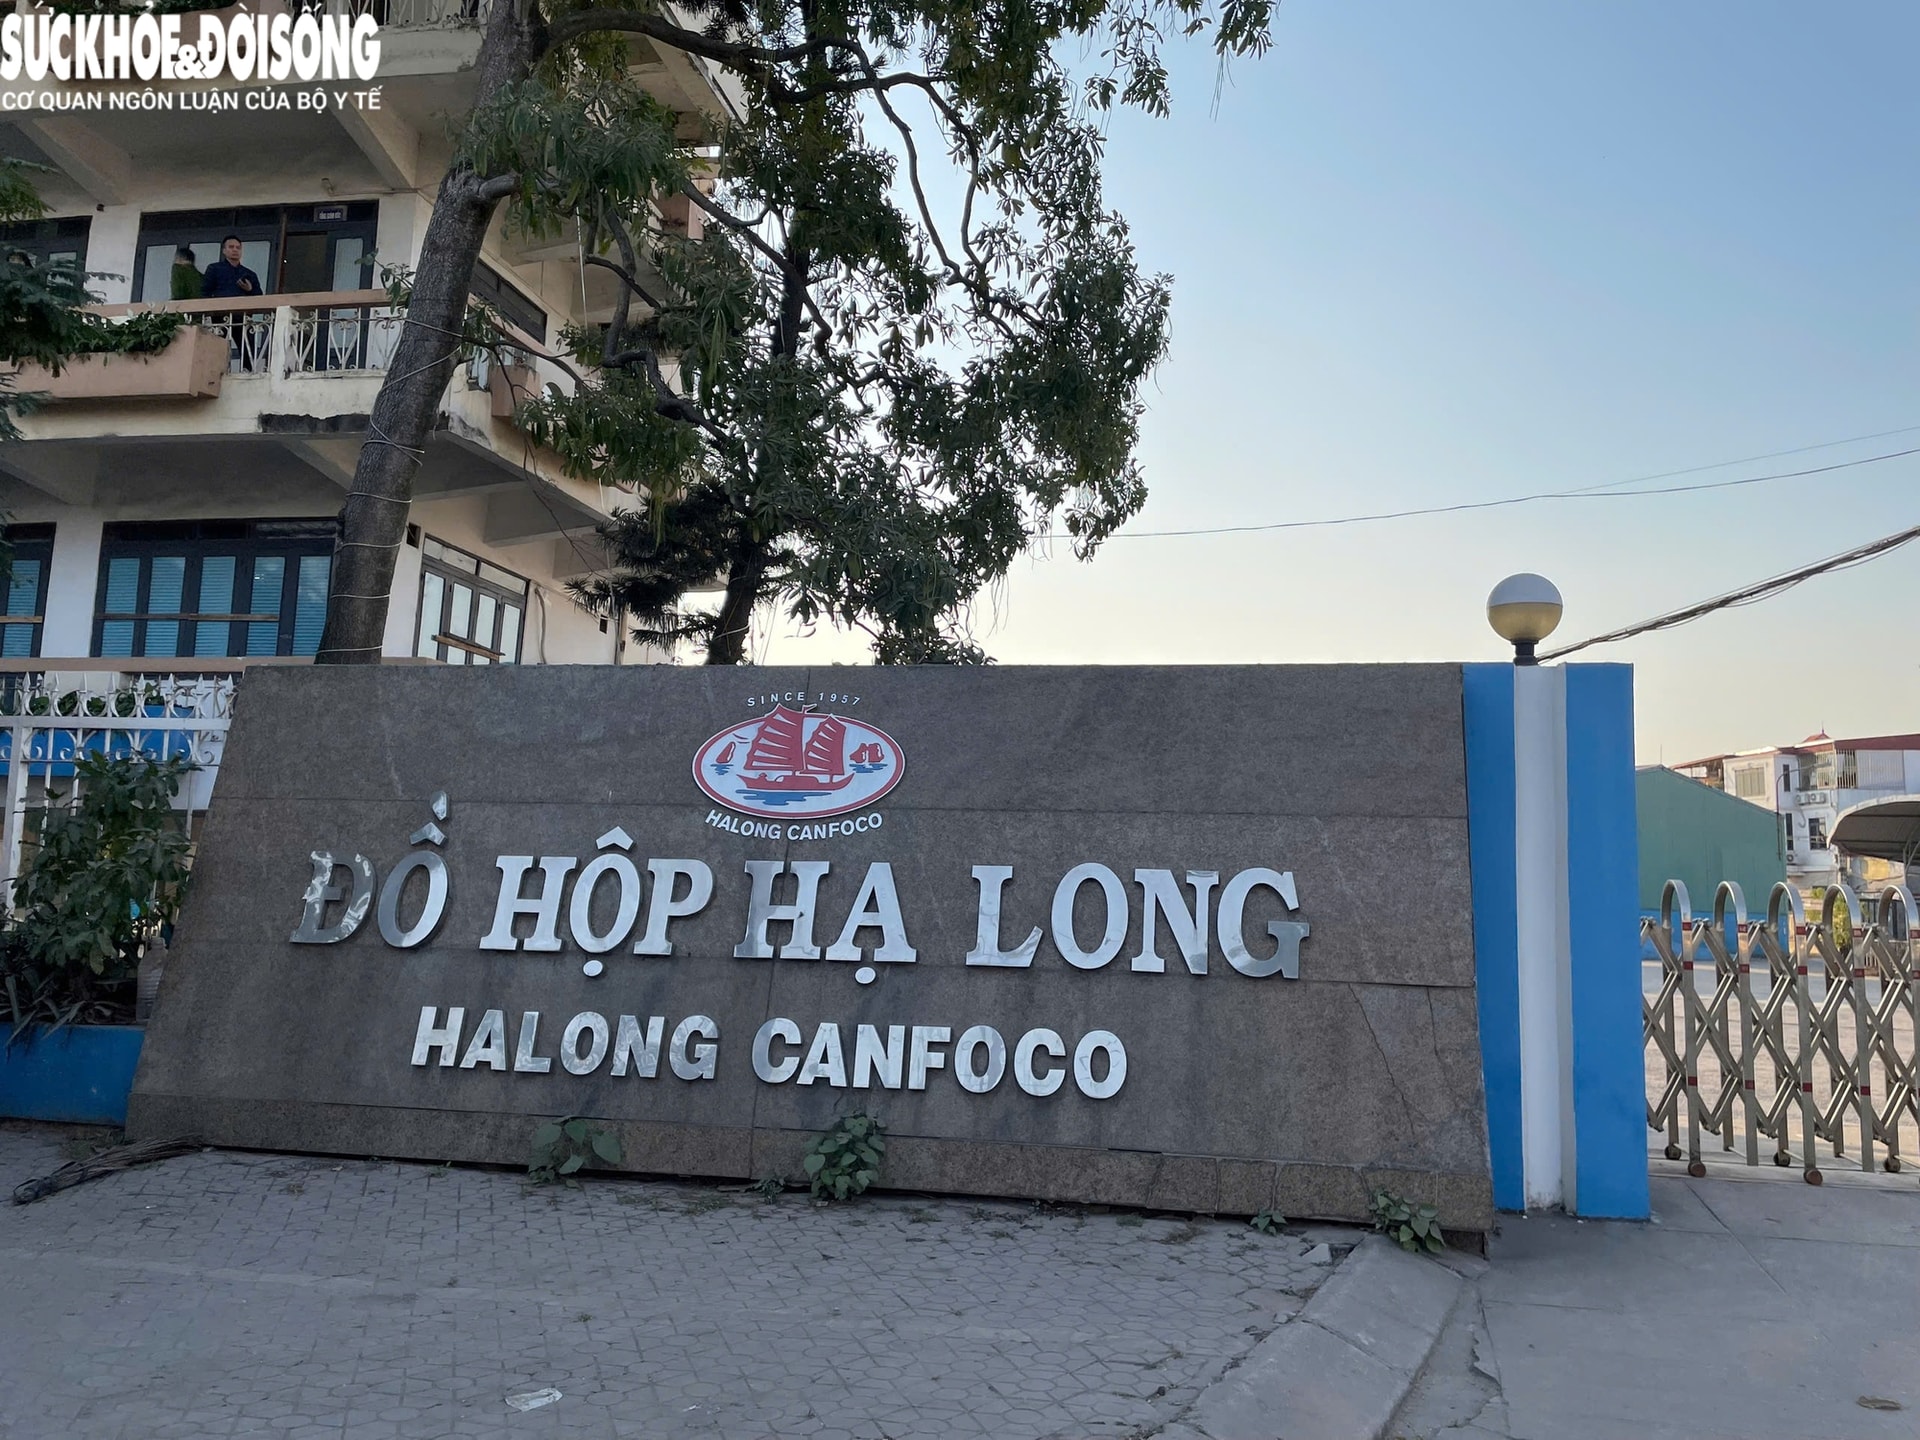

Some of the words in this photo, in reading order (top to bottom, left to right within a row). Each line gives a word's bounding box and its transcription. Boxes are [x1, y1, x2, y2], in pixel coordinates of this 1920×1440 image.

[747, 691, 805, 707] SINCE
[818, 691, 861, 706] 1957
[705, 809, 782, 840] HALONG
[786, 812, 883, 841] CANFOCO
[290, 791, 450, 948] ĐỒ
[479, 826, 714, 977] HỘP
[733, 860, 917, 985] HẠ
[965, 862, 1310, 980] LONG
[410, 1005, 720, 1080] HALONG
[751, 1016, 1128, 1099] CANFOCO
